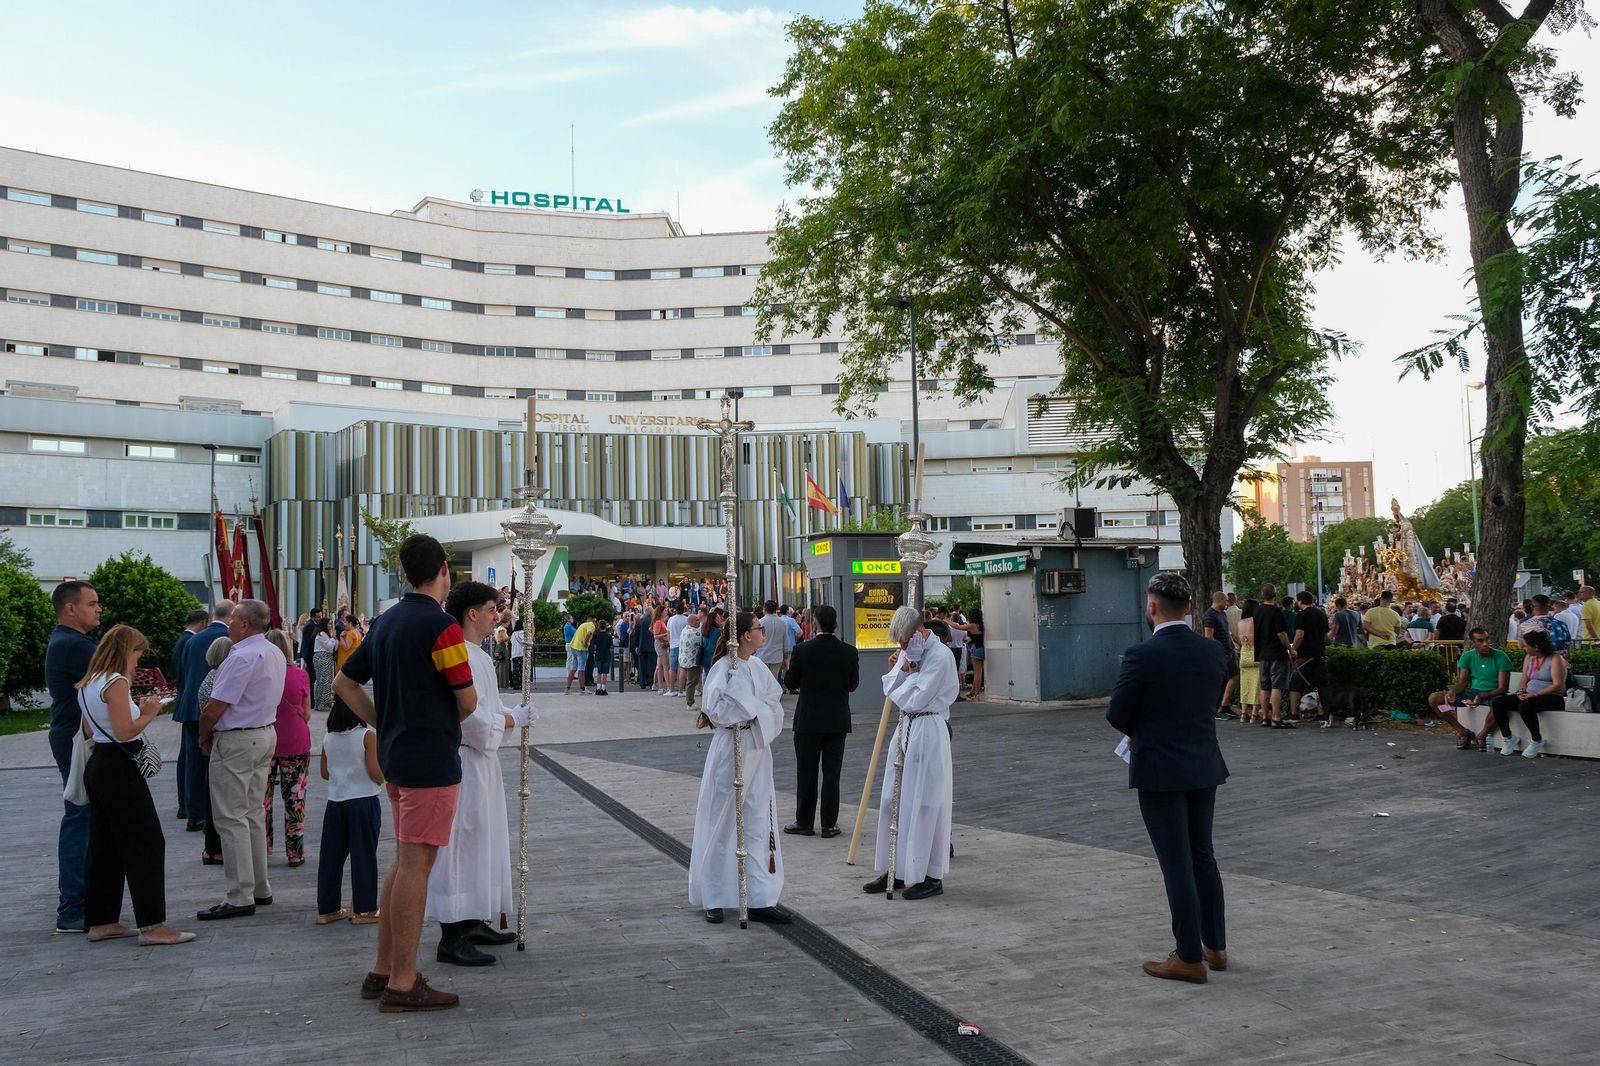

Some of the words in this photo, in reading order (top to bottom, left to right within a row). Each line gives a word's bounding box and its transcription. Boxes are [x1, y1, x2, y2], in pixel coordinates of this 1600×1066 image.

[491, 190, 631, 213] HOSPITAL
[609, 415, 705, 426] UNIVERSITARI
[867, 563, 897, 571] ONCE
[984, 559, 1013, 574] Kiosko
